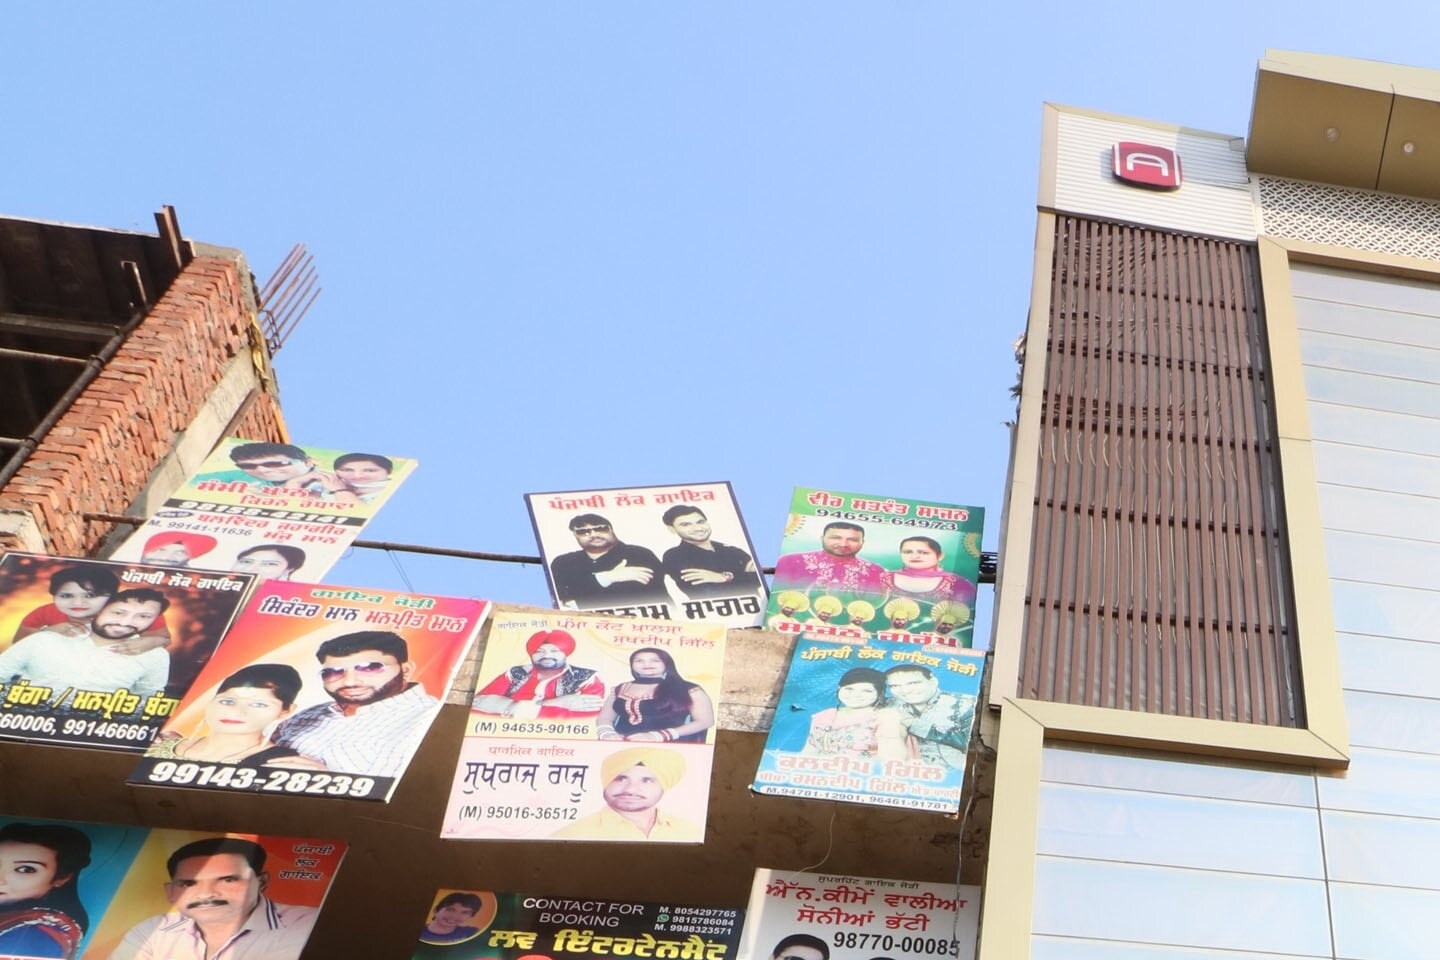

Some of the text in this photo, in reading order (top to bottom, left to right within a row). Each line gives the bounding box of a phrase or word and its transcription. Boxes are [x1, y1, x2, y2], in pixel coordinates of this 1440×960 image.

[548, 489, 716, 511] ਪੰਜਾਬੀ ਲੋਕ ਗਾਇਕ
[807, 492, 844, 508] ਵੀਰ
[916, 506, 970, 522] ਸਾਜਨ
[178, 501, 350, 525] 98158-42141
[121, 569, 244, 592] ਪੰਜਾਬੀ ਲੋਕ ਗਾਇਕ
[312, 590, 384, 603] ਗਾਇਕ
[682, 596, 761, 619] ਸਾਗਰ
[259, 597, 467, 632] ਸਿਕੰਦਰ ਮਾਨ ਮਨਪ੍ਰੀਤ ਮਾਨ
[801, 646, 853, 662] ਪੰਜਾਬੀ
[857, 646, 887, 661] ਲੋਕ
[891, 650, 942, 668] ਗਾਇਕ
[72, 689, 141, 720] ਮਨਪ੍ਰੀਤ
[474, 721, 590, 735] (M) 94635-90166
[536, 745, 576, 757] ਗਾਇਕ
[148, 761, 375, 797] 99143-28239
[463, 762, 590, 803] ਸੁਖਰਾਜ ਰਾਜੂ
[458, 805, 578, 821] (M) 95016-36512
[523, 897, 645, 916] CONTACT FOR
[658, 906, 737, 919] M. 8054297765
[539, 912, 620, 928] BOOKING
[671, 915, 734, 927] 9815786084
[796, 904, 931, 932] ਸੋਨੀਆਂ ਭੱਟੀ
[487, 929, 539, 950] ਲਵ
[654, 923, 732, 936] M. 9988323571
[833, 931, 960, 958] 98770-00085
